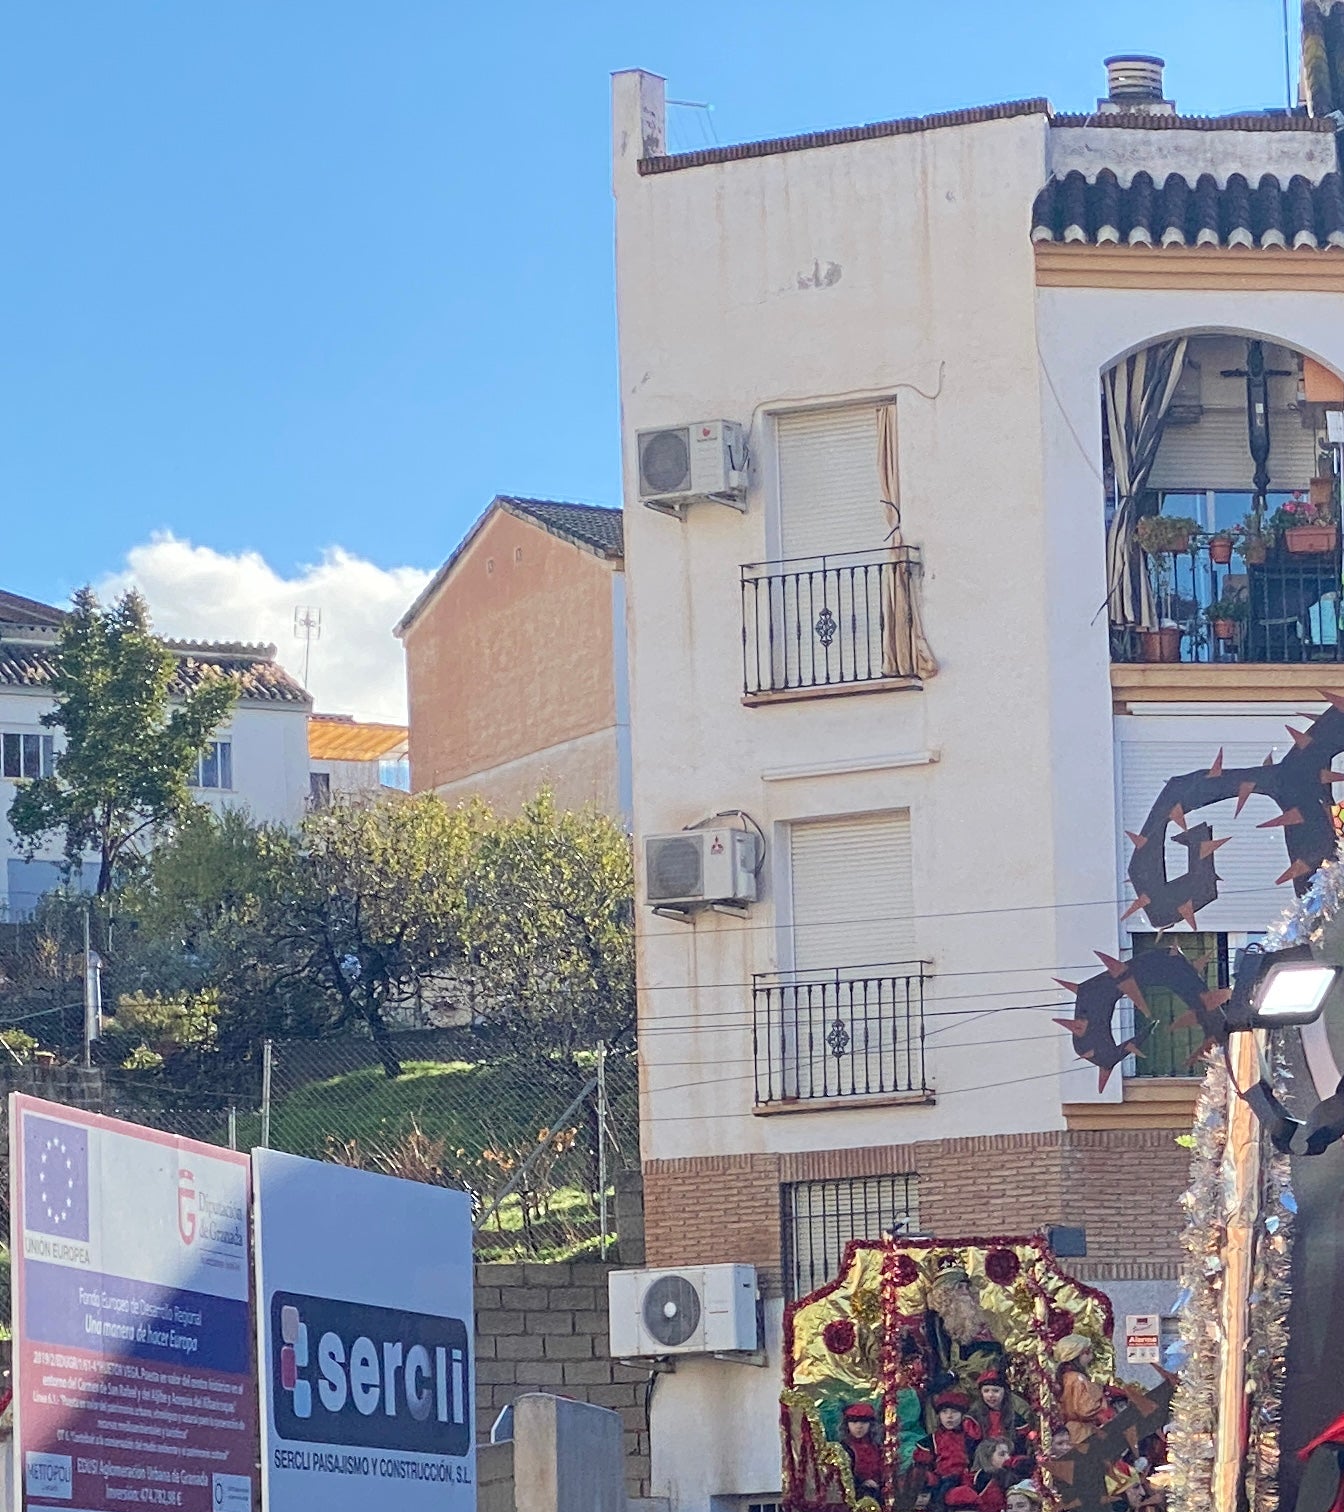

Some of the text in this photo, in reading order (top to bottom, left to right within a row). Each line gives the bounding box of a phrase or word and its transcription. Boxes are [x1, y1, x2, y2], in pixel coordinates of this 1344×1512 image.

[25, 1237, 90, 1264] UNIÓN EUROPEA
[85, 1314, 198, 1354] Una manera de hacer Europa
[318, 1331, 464, 1424] sercli
[274, 1449, 310, 1471] SERCLI
[313, 1452, 370, 1476] PAISAJISMO
[371, 1458, 379, 1476] Y
[457, 1466, 471, 1484] S.L.
